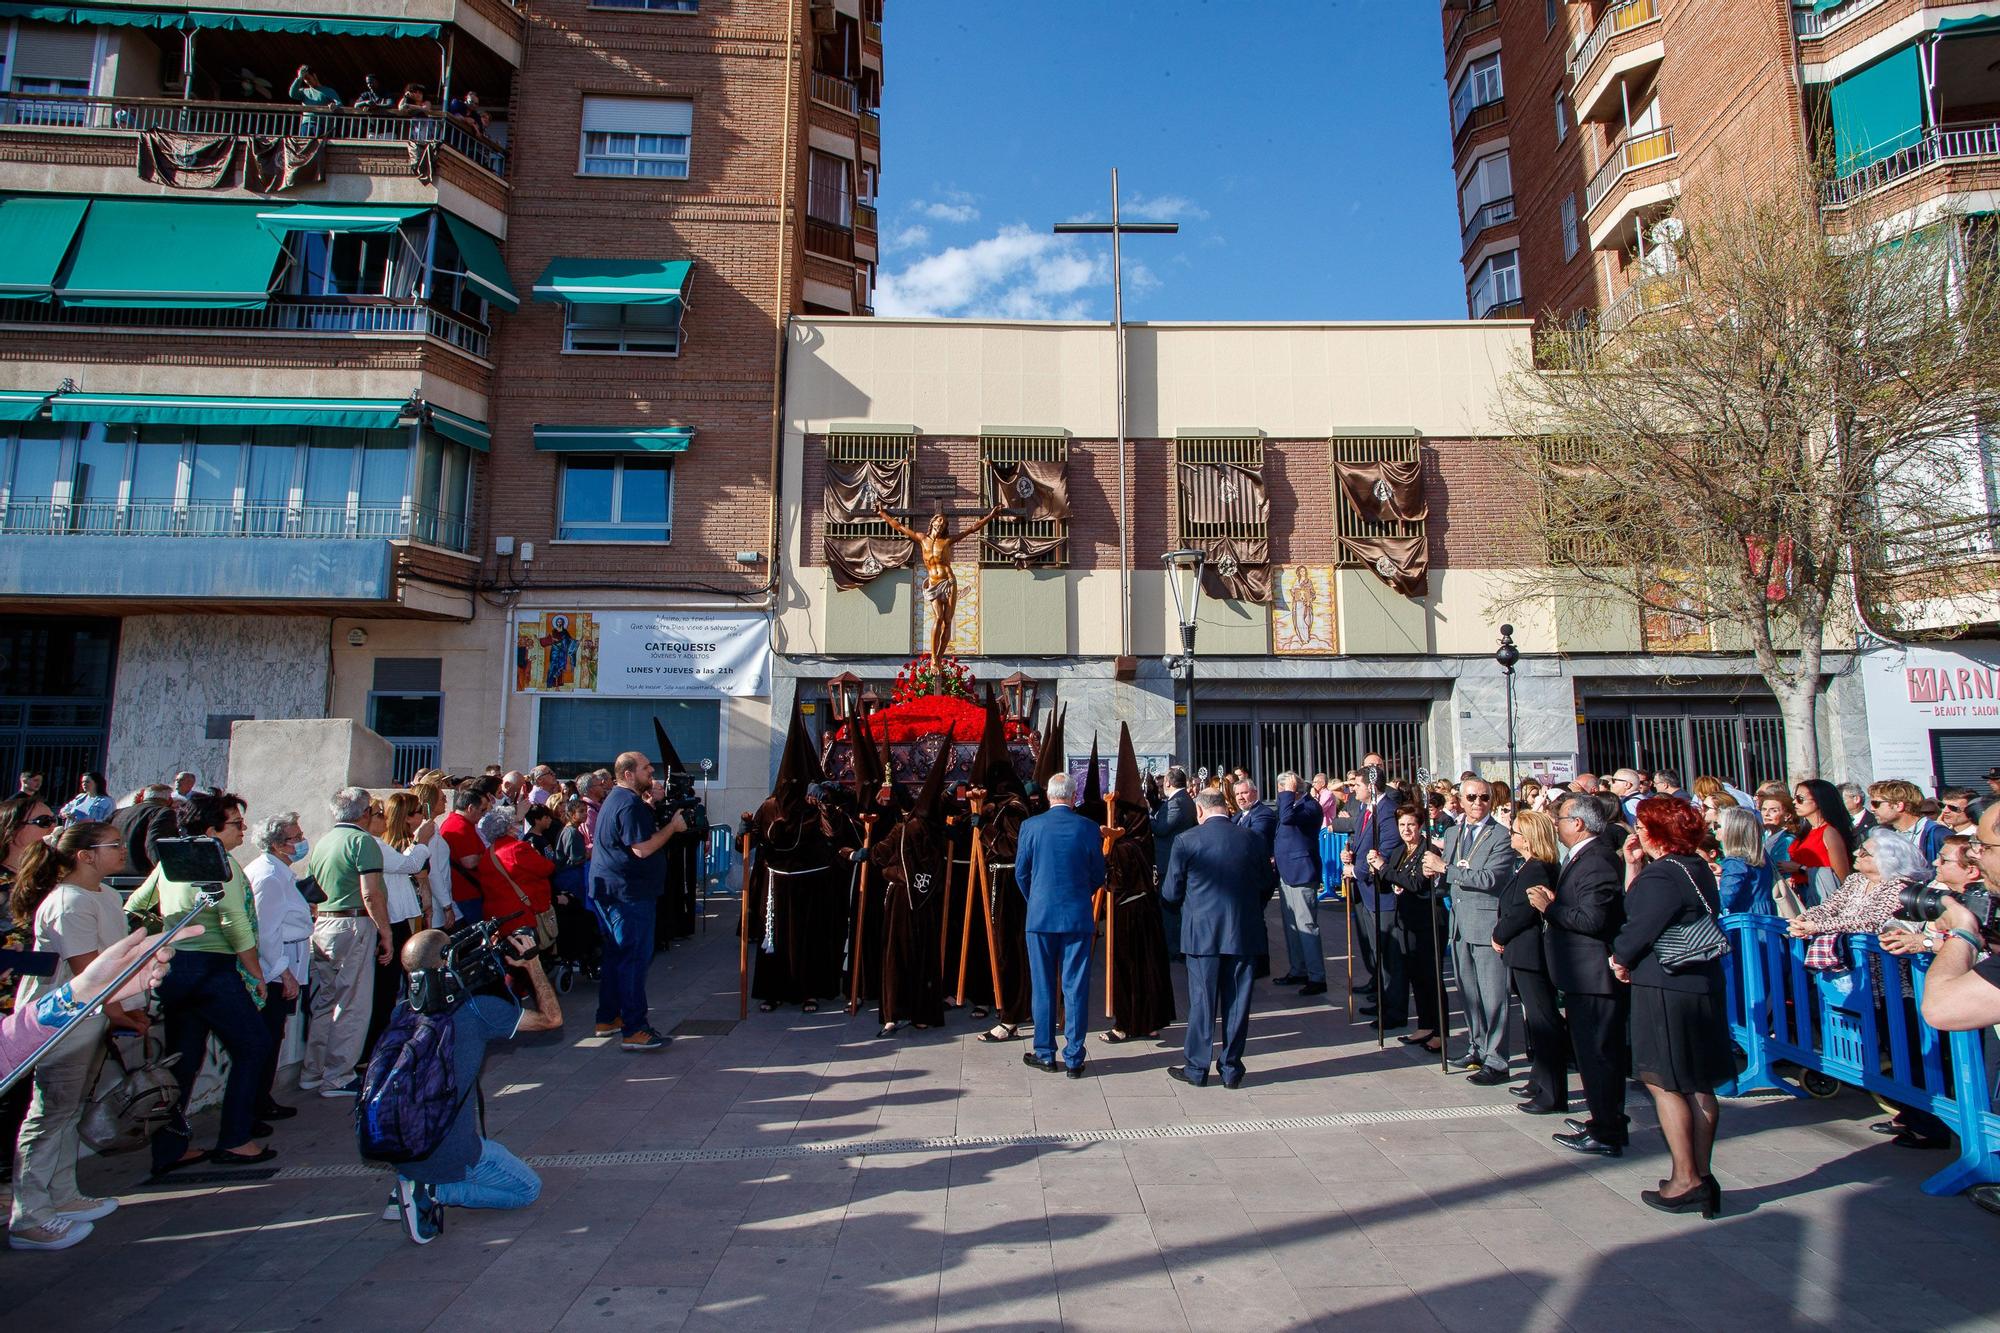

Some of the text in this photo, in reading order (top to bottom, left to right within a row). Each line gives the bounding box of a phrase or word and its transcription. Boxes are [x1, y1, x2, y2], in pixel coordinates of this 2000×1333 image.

[630, 623, 643, 631] Que
[645, 642, 716, 652] CATEQUESIS
[1934, 706, 1999, 716] BEAUTY SALON
